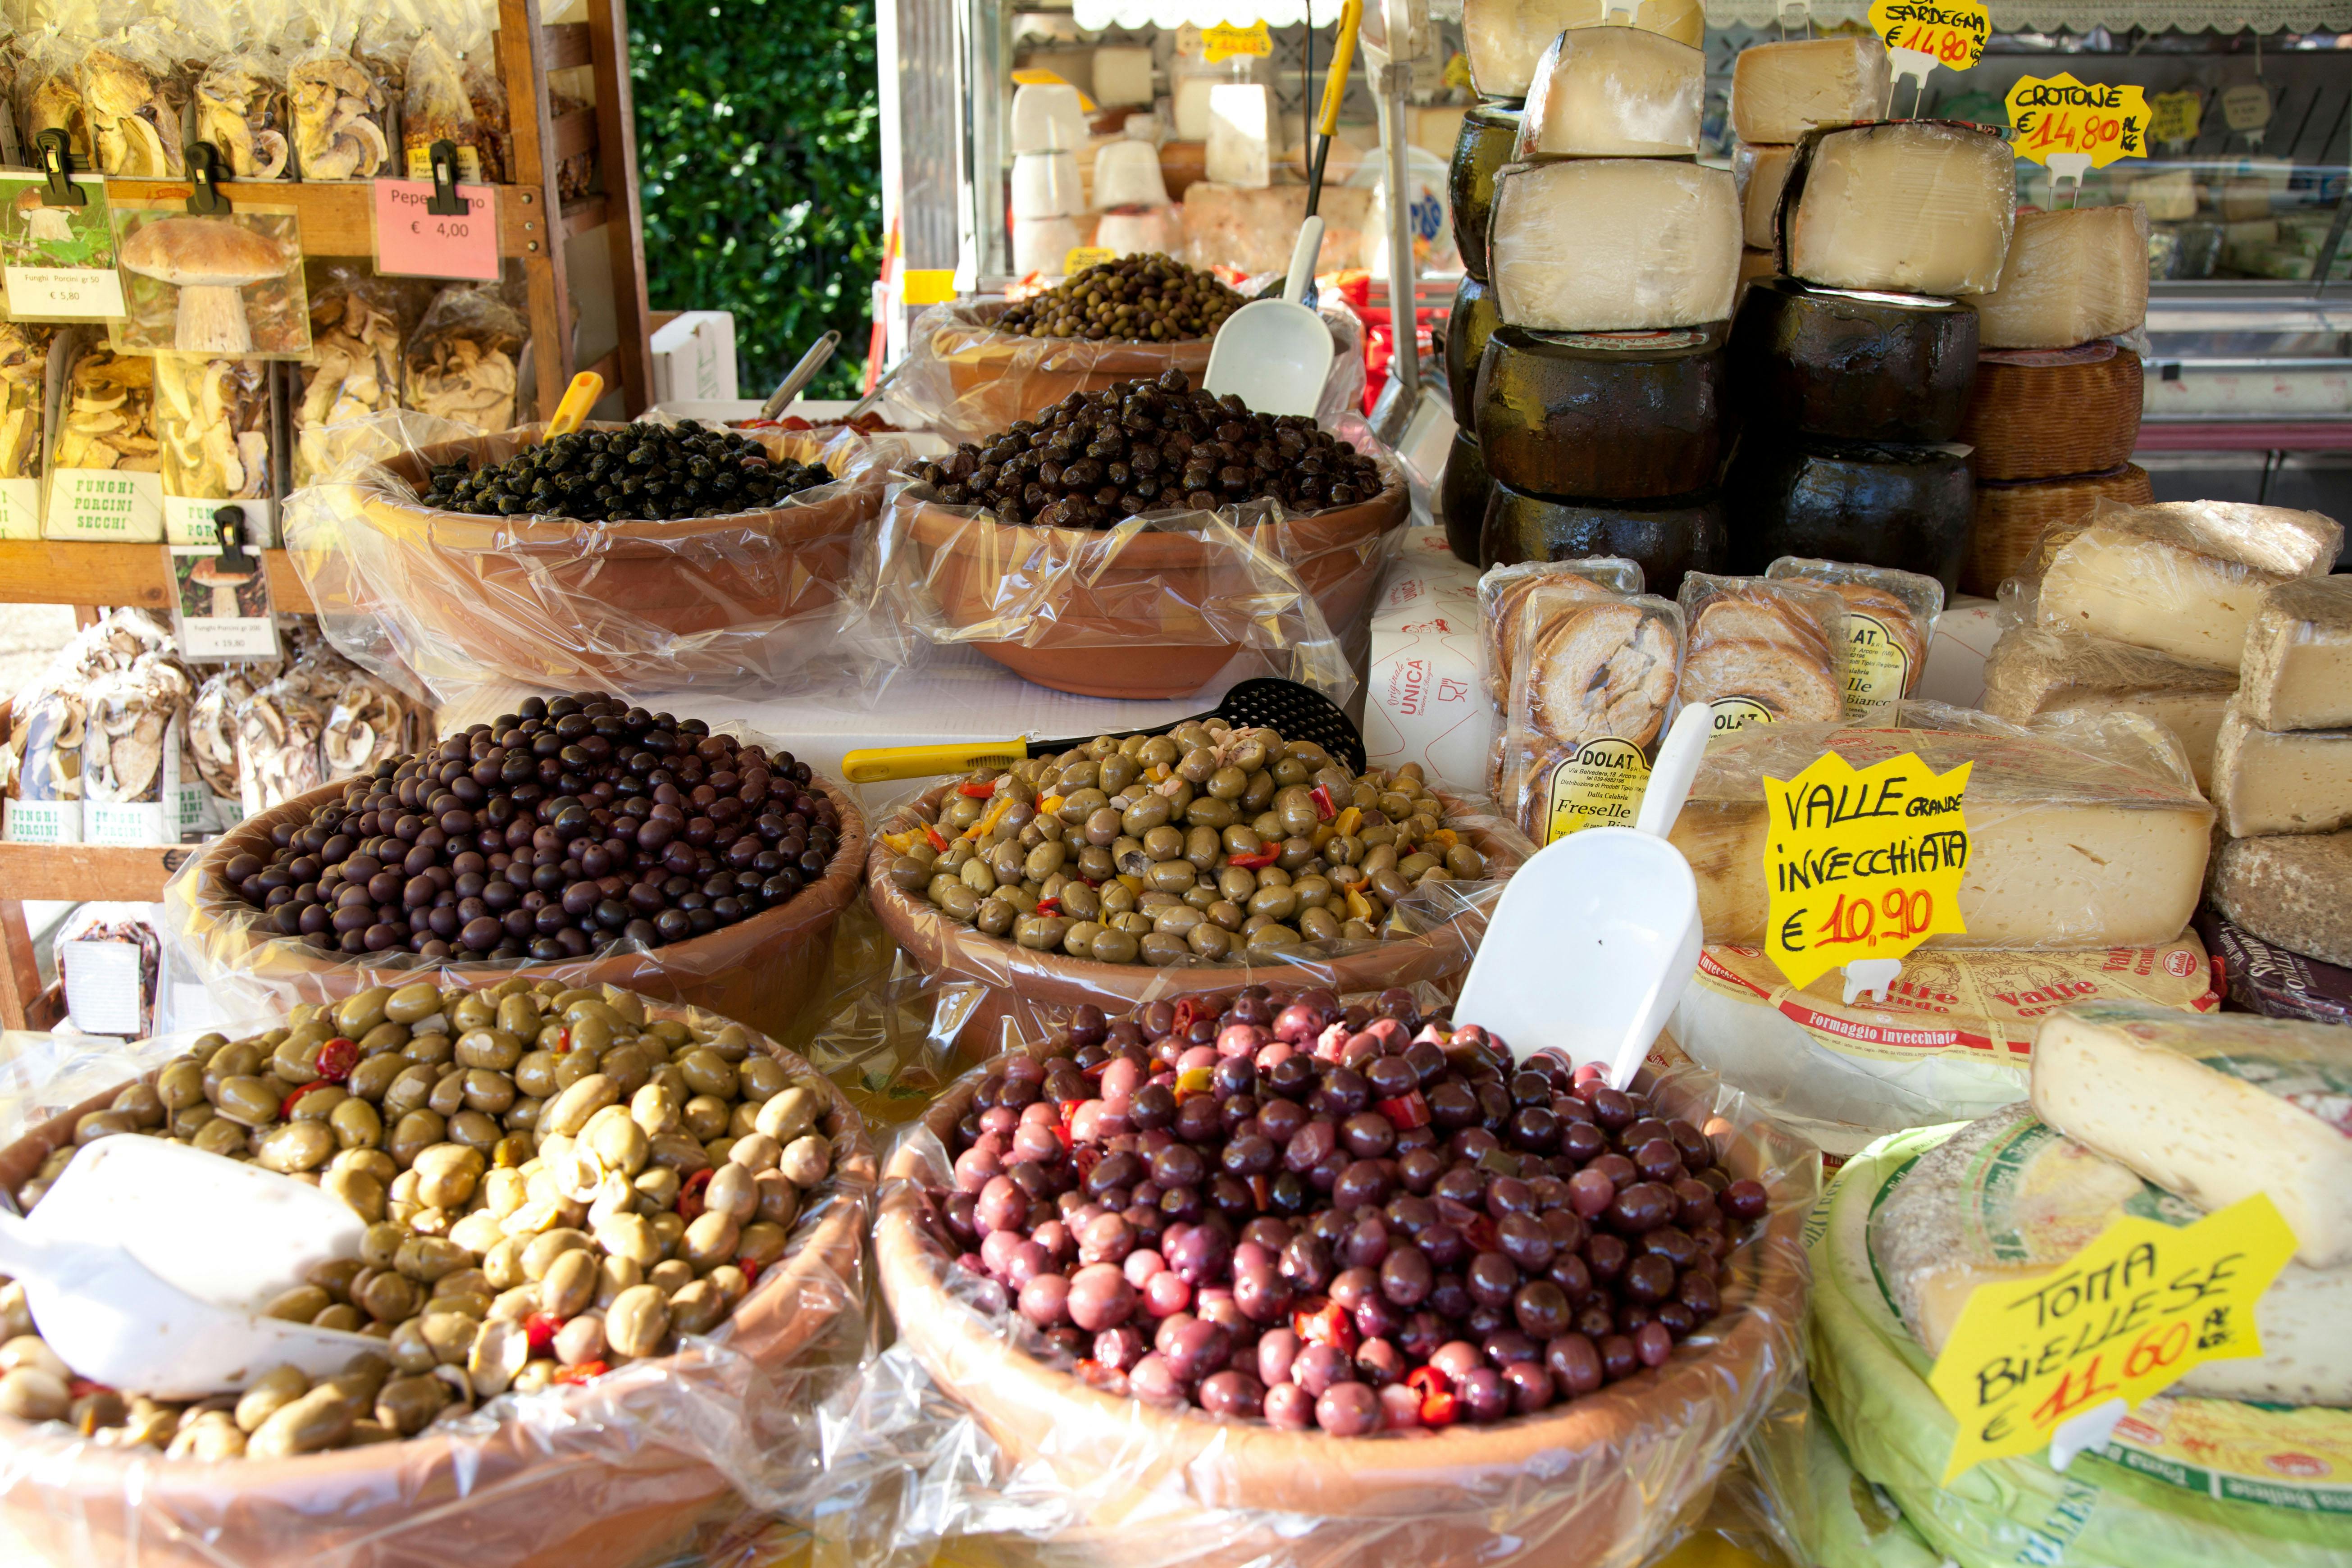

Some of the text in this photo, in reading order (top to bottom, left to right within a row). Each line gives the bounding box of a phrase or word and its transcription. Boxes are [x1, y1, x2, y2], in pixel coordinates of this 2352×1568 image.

[1886, 5, 1985, 33] SARDEGNA
[2015, 85, 2123, 108] CROTONE
[2017, 111, 2036, 133] €
[391, 190, 485, 208] Pepeno
[411, 221, 469, 238] € 4,00
[25, 274, 49, 283] Funghi
[60, 292, 80, 301] 5,80
[76, 480, 134, 494] FUNGHI
[74, 497, 132, 512] PORCINI
[188, 506, 215, 520] FUN
[77, 516, 127, 530] SECCHI
[1402, 579, 1418, 602] UNICA
[1387, 661, 1405, 706] Originale
[1400, 660, 1423, 715] UNICA
[1582, 750, 1635, 769] DOLAT
[1604, 792, 1628, 800] Calabria
[1785, 776, 1964, 831] VALLE GRANDE
[12, 809, 59, 822] FUNGHI
[96, 811, 142, 824] FUNGHI
[1554, 799, 1631, 818] Freselle
[12, 824, 59, 837] PORCINI
[1782, 887, 1933, 952] € 10,90
[2101, 948, 2136, 972] Vall
[1809, 1012, 1878, 1040] Formaggio
[1882, 1029, 1957, 1045] invecchiato
[2006, 1242, 2157, 1329] TOMA
[1981, 1403, 2017, 1443] €
